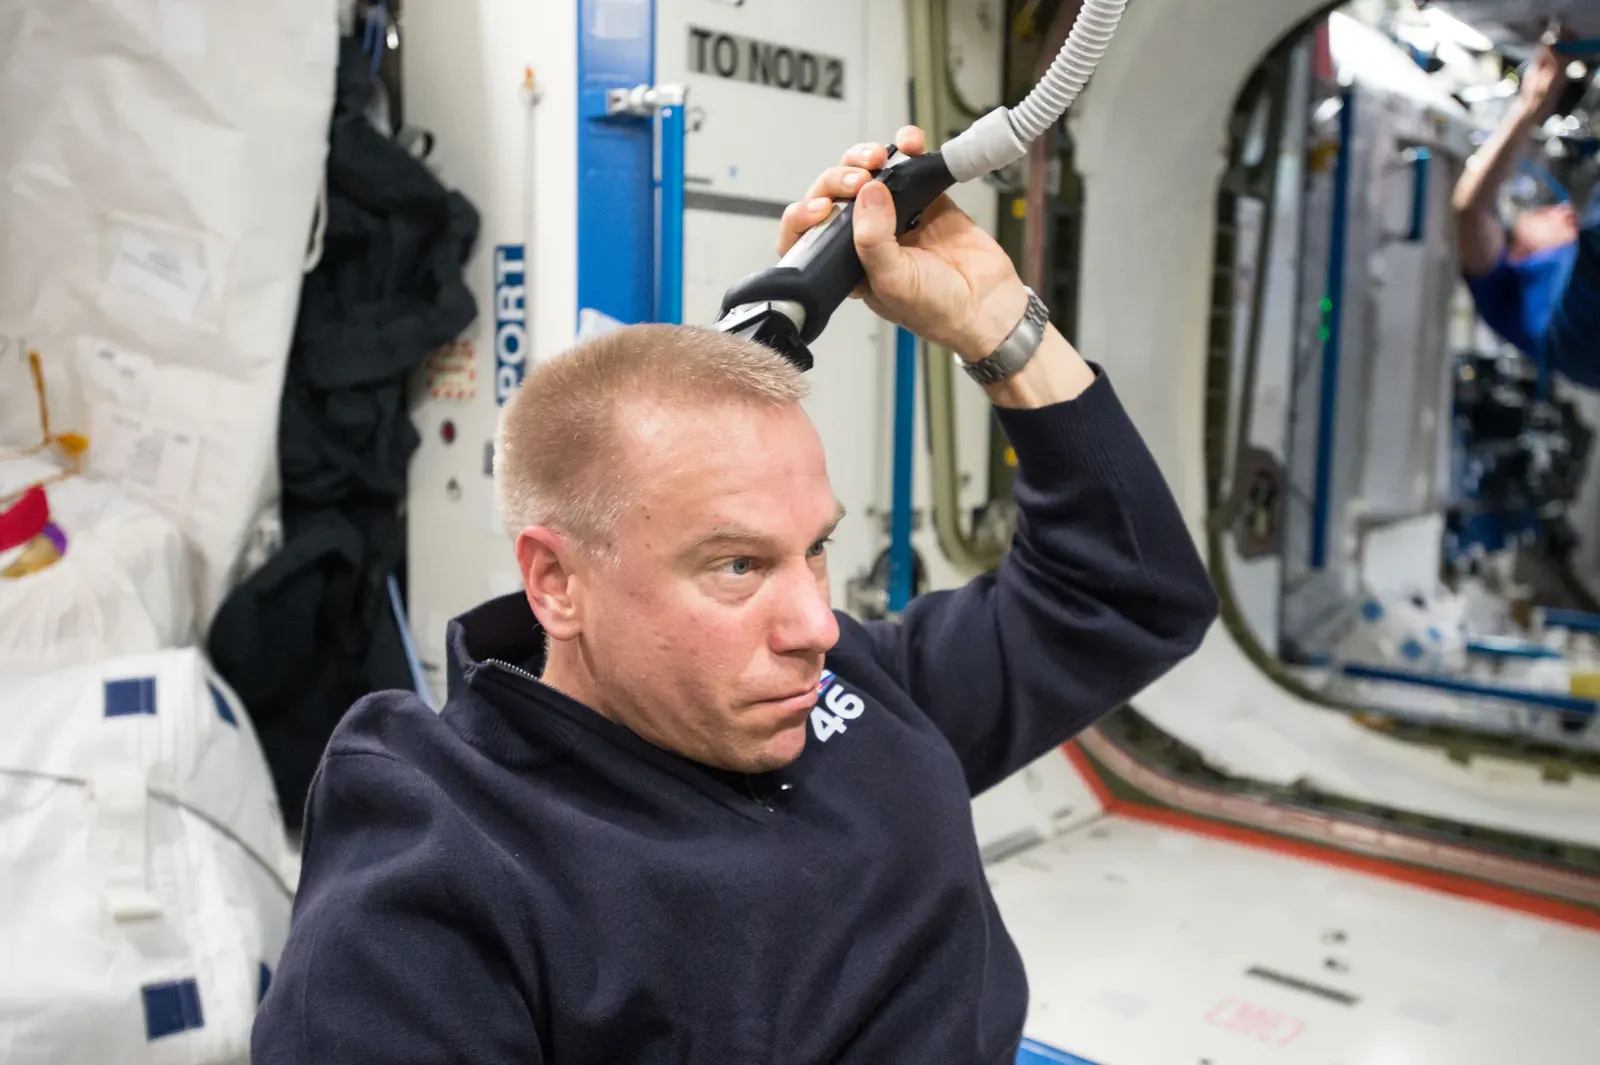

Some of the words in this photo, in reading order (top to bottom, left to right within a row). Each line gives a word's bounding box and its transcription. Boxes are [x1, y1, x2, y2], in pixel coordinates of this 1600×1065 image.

[690, 27, 737, 78] TO
[748, 41, 819, 93] NOD
[826, 59, 844, 100] 2
[496, 248, 527, 397] PORT
[809, 683, 865, 743] 46
